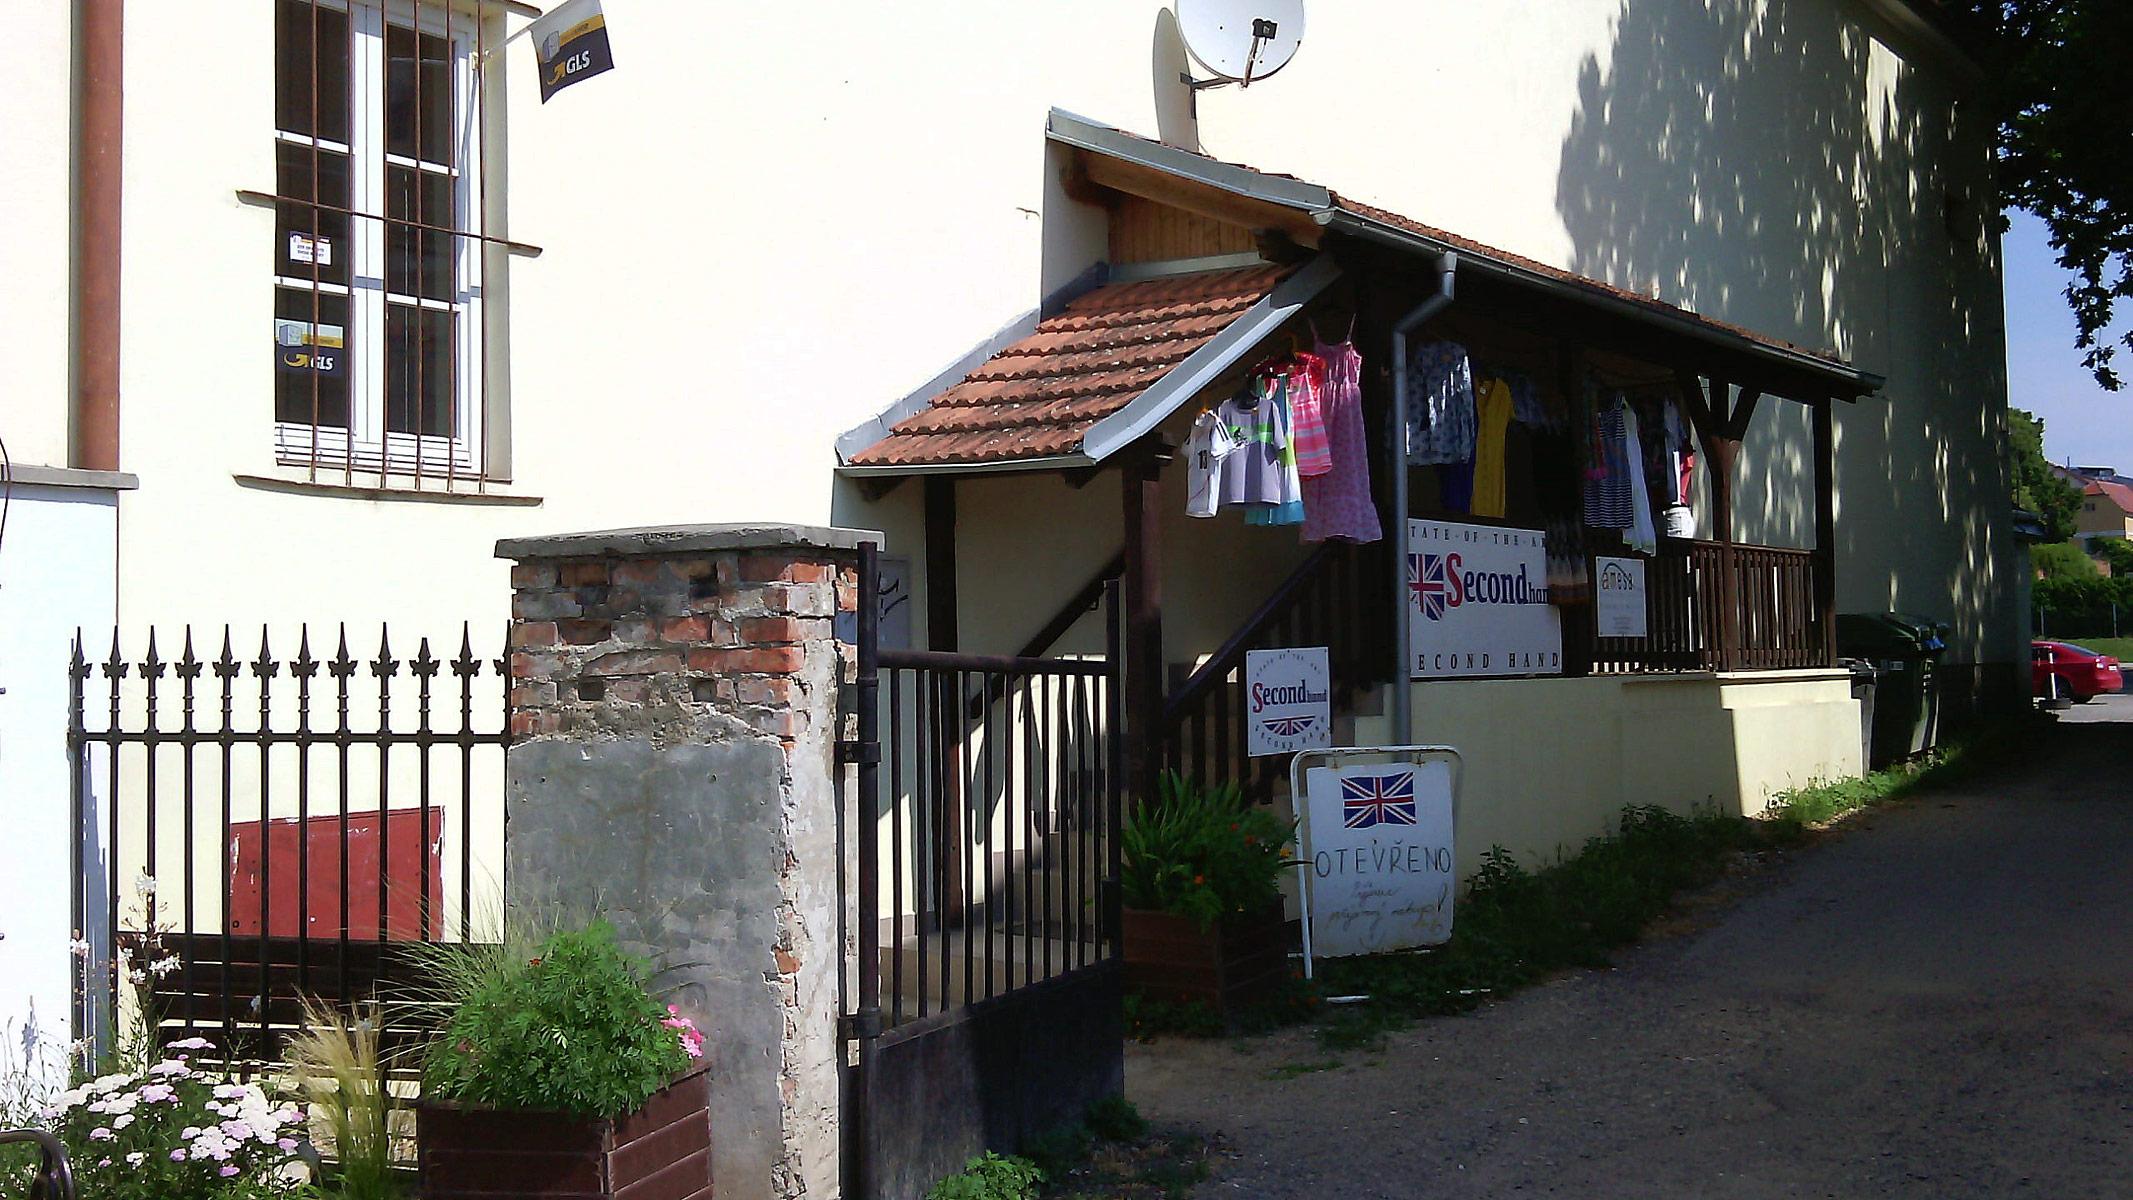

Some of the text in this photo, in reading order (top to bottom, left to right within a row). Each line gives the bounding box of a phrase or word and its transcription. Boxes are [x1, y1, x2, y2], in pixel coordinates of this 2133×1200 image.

[566, 50, 591, 74] GLS
[1411, 525, 1450, 542] TATE
[1464, 530, 1478, 544] OF
[1493, 533, 1519, 547] THE
[1528, 581, 1550, 605] han
[1418, 652, 1559, 671] ECOND HAND
[1315, 839, 1451, 878] OTEVŘENO
